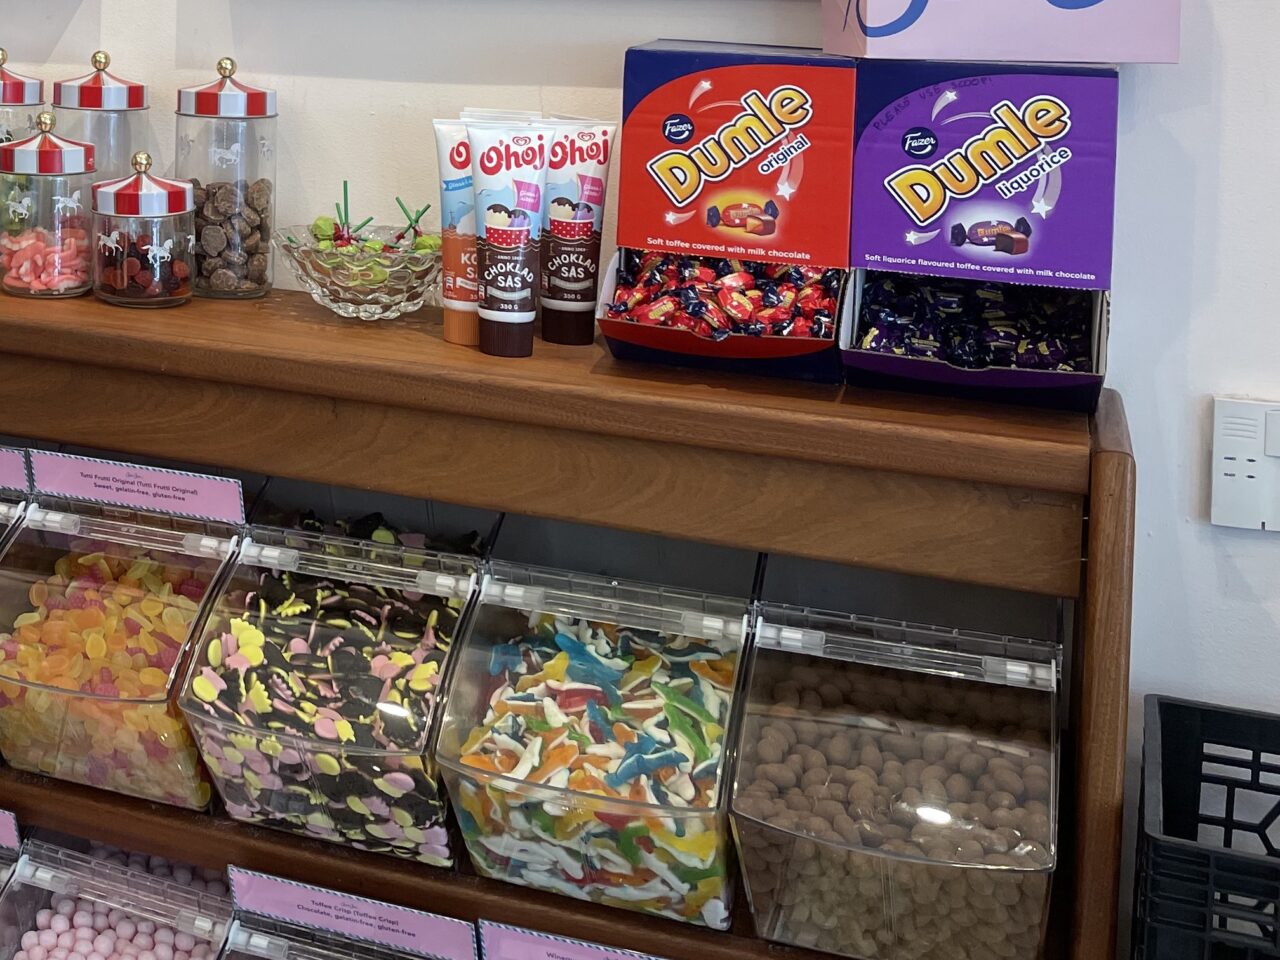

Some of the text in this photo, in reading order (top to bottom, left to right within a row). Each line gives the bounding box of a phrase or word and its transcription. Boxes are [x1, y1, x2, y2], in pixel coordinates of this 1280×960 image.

[664, 118, 693, 138] Fazer
[549, 130, 608, 170] O'hoj
[647, 86, 811, 206] Dumle
[905, 132, 936, 151] Fazer
[480, 134, 545, 175] O'hoj
[760, 135, 809, 173] original
[887, 97, 1069, 224] Dumle
[997, 148, 1069, 197] liquorice
[647, 237, 810, 260] Soft toffee covered with milk chocolate
[484, 262, 534, 283] CHOKLAD
[548, 254, 596, 273] CHOKLAD
[560, 266, 585, 278] SÅS
[865, 253, 1096, 280] Soft liquorice flavoured toffee covered with milk chocolate
[497, 275, 522, 288] SÅS
[94, 474, 111, 482] Frutti
[112, 476, 136, 486] Original
[136, 480, 152, 489] (Tutti
[153, 483, 170, 491] Frutti
[171, 486, 198, 496] Original)
[94, 482, 185, 501] Sweet, gelatin-free, gluten-free
[296, 904, 417, 937] Chocolate, gelatin-free, gluten-free
[311, 900, 332, 910] Toffee
[334, 905, 352, 915] Crisp
[353, 910, 377, 920] (Toffee
